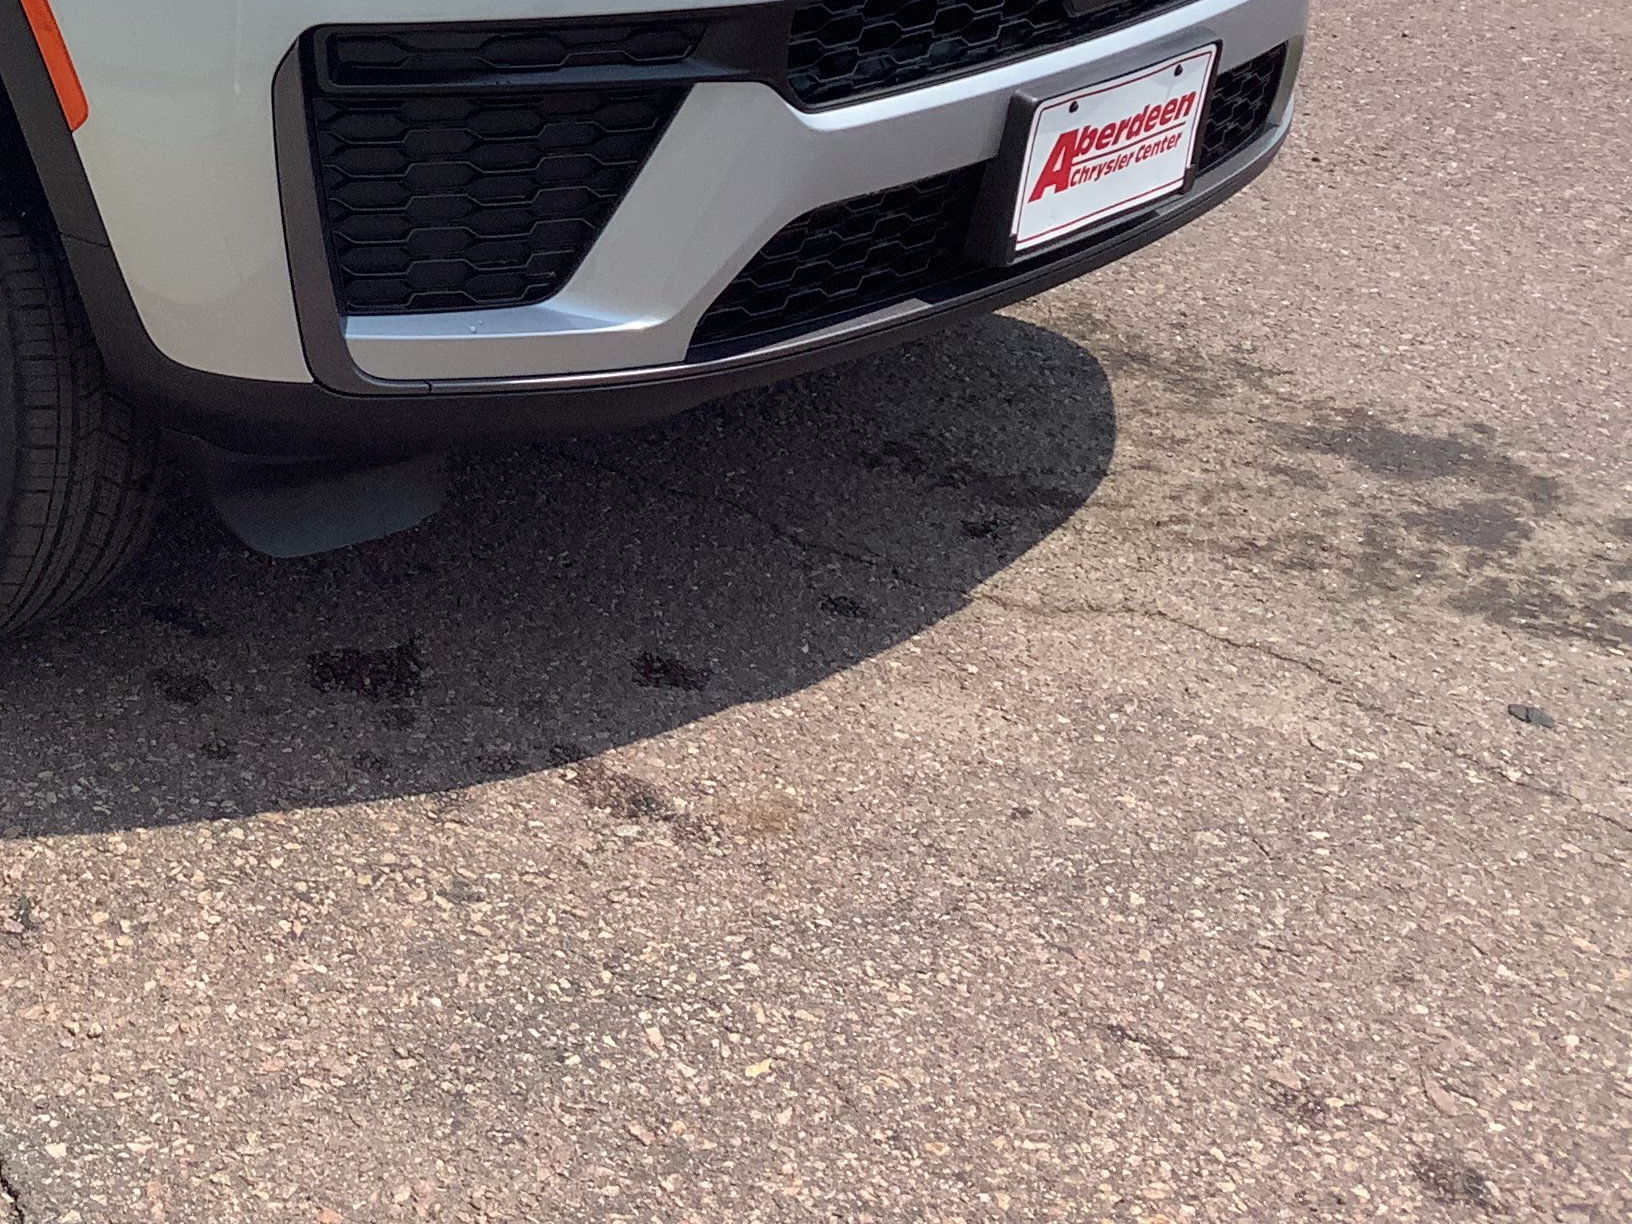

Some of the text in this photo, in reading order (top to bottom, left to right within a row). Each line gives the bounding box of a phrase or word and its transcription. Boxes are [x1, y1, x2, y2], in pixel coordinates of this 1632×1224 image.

[1027, 90, 1197, 204] Aberdeen
[1069, 131, 1182, 188] Chrysler Center
